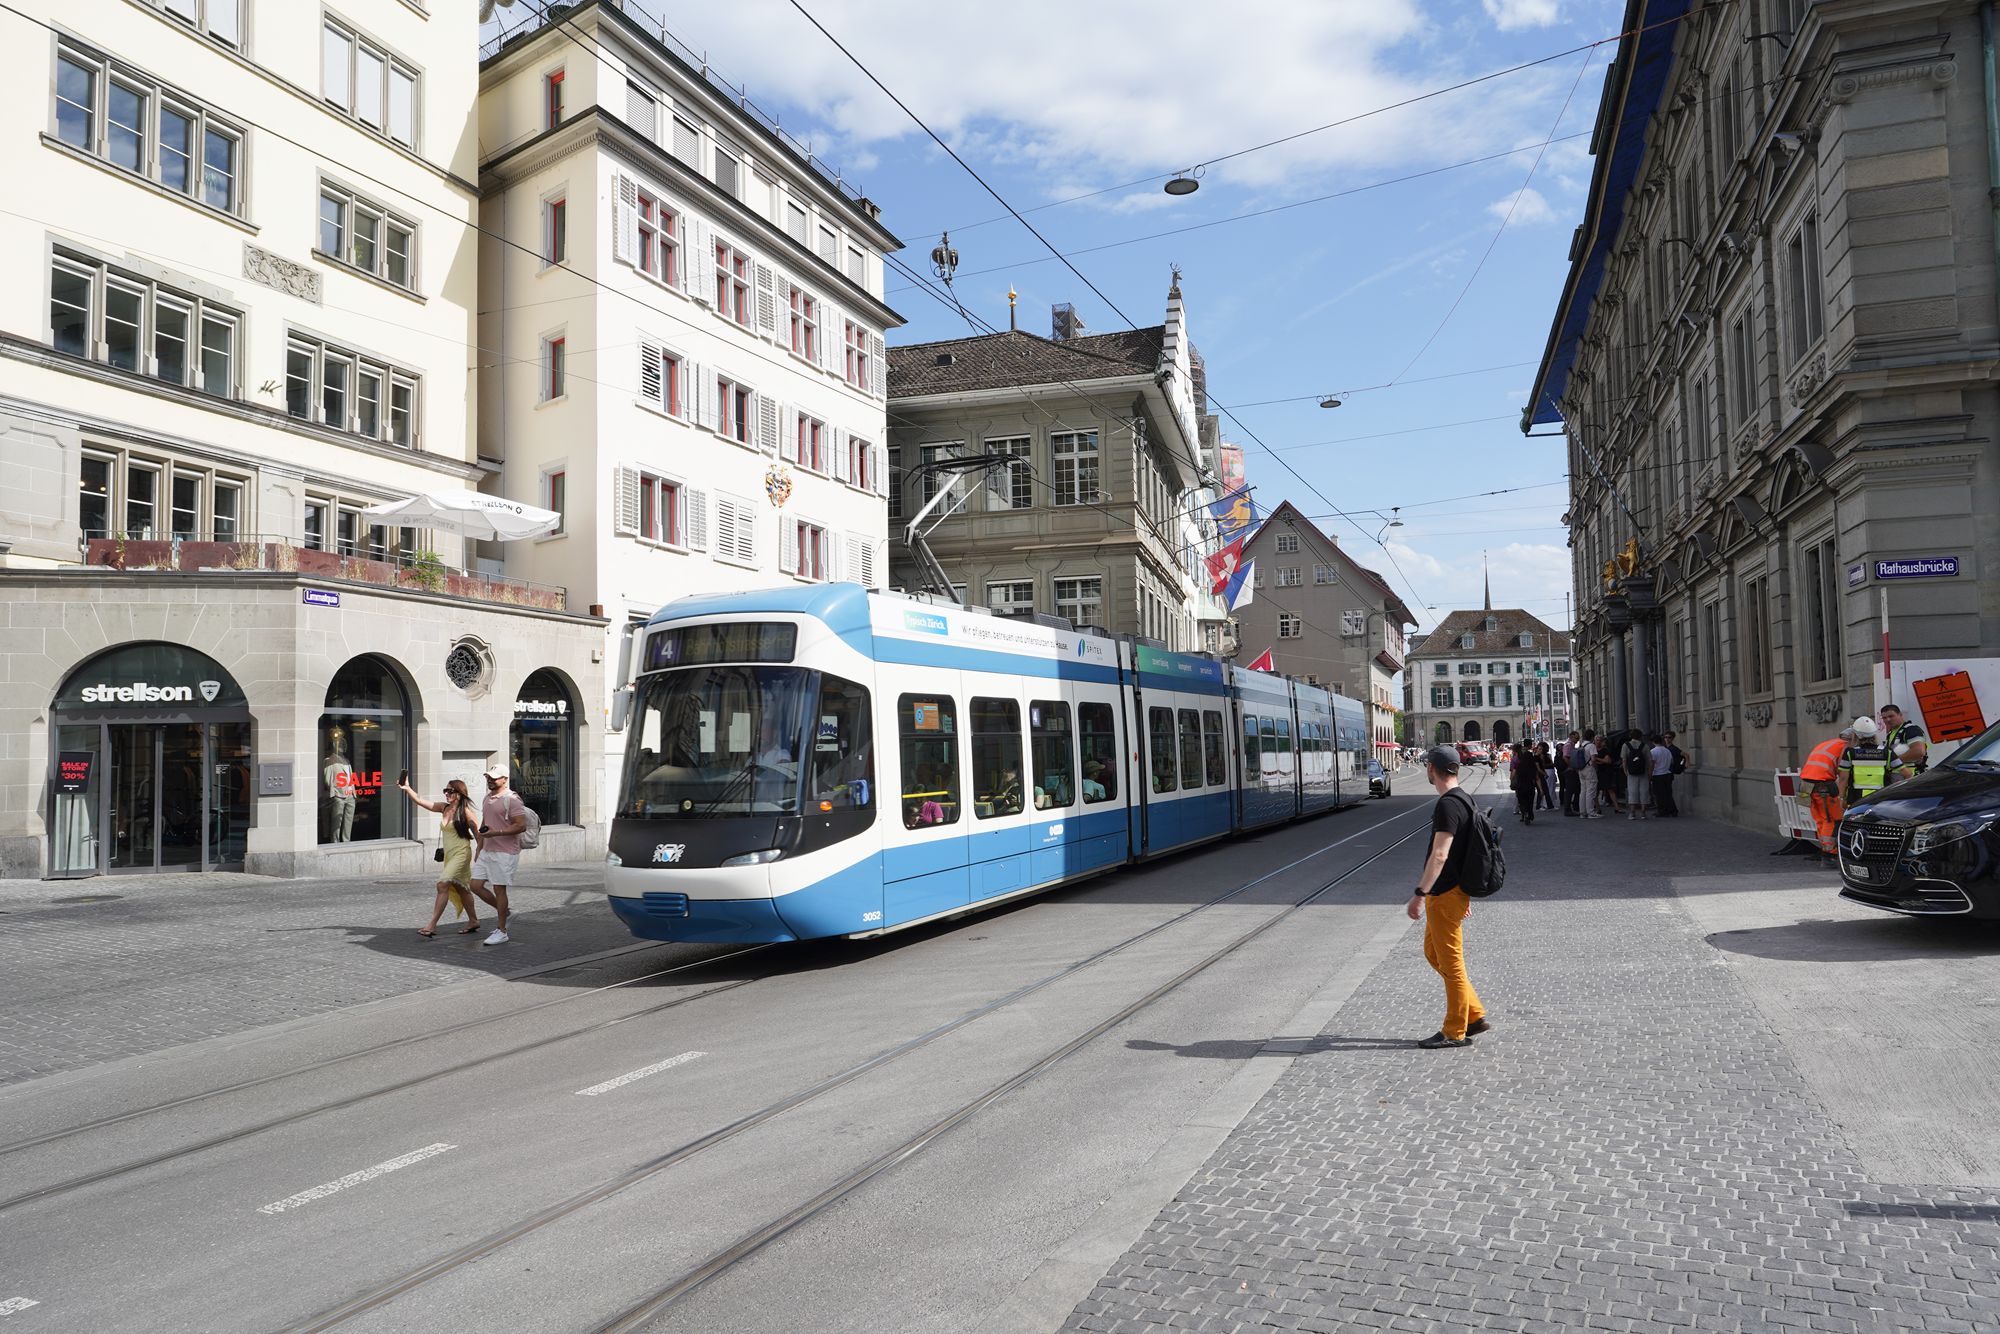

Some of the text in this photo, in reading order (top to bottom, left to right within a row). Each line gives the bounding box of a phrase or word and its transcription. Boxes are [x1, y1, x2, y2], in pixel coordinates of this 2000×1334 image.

[1880, 560, 1954, 575] Rathausbrücke
[661, 640, 673, 659] 4
[1086, 645, 1103, 655] SPITEX
[81, 682, 192, 702] strellson
[514, 700, 556, 713] strellson
[64, 772, 86, 780] 30%
[335, 771, 384, 788] SALE
[519, 785, 550, 794] TOURIST
[863, 911, 881, 922] 3052
